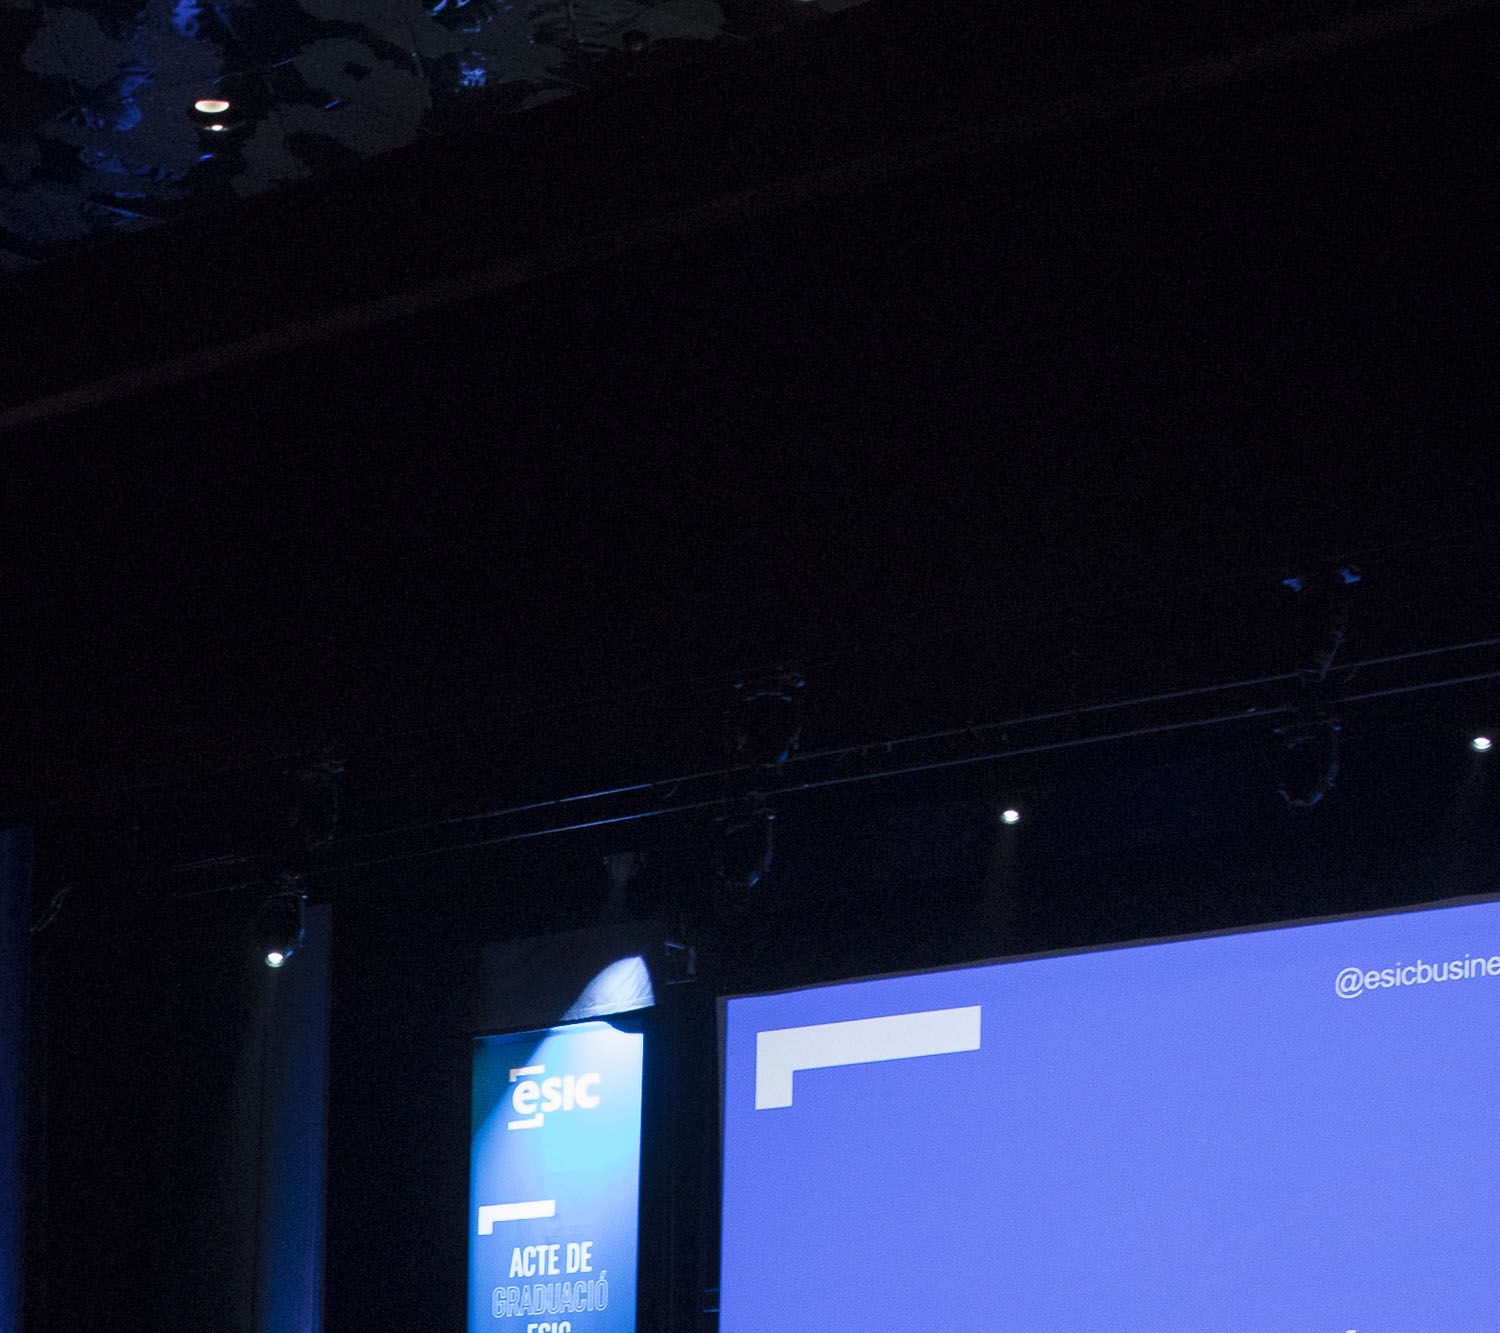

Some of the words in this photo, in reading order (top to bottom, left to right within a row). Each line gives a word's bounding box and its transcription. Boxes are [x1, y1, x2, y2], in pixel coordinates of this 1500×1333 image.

[511, 1072, 601, 1115] esic
[509, 1244, 559, 1278] ACTE
[566, 1241, 593, 1274] DE
[491, 1270, 609, 1318] GRADUACIÓ
